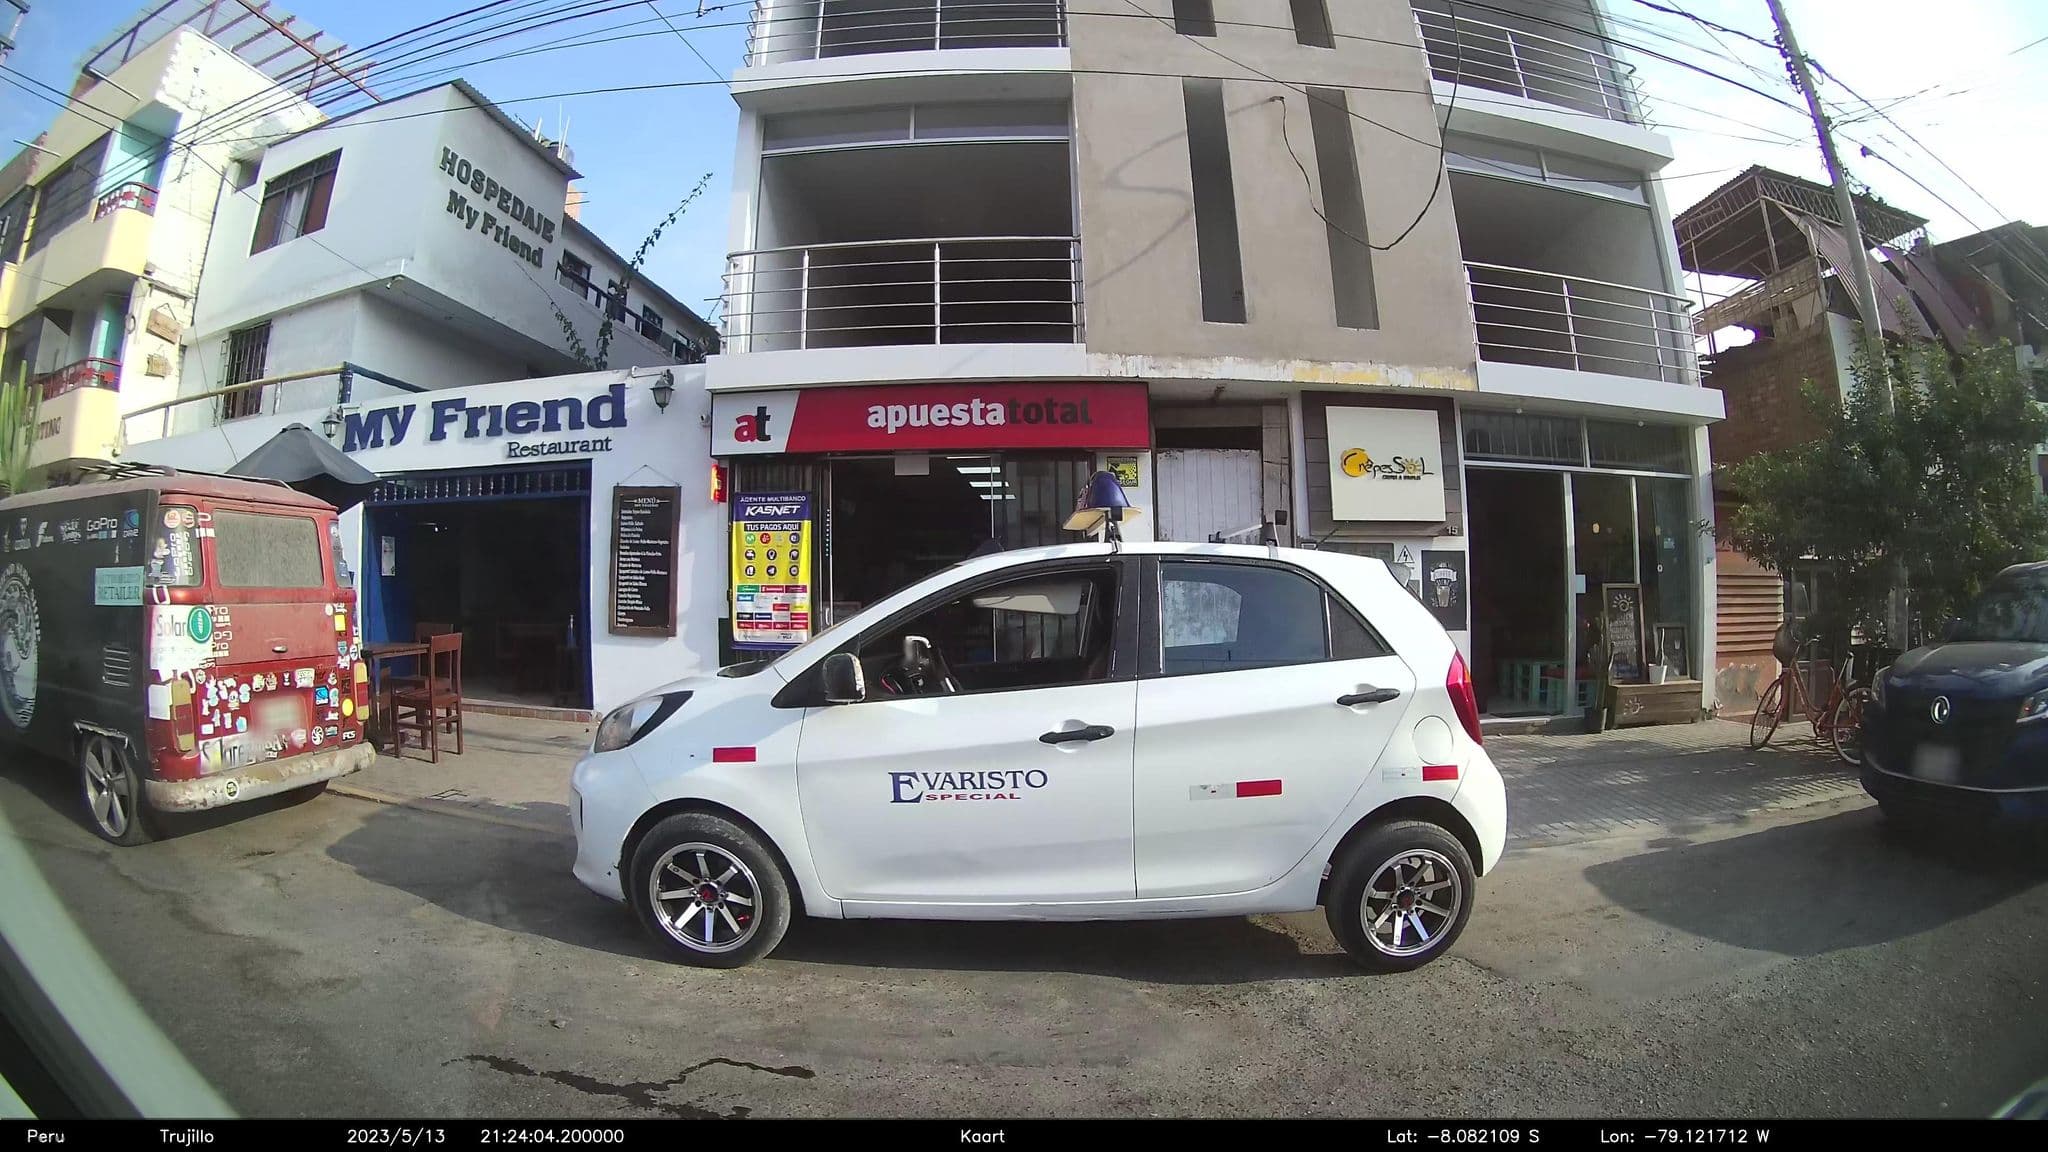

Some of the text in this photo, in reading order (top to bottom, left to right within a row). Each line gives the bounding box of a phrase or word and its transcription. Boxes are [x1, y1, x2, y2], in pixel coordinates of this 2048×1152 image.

[440, 146, 556, 244] HOSPEDAJE
[446, 189, 544, 269] My Friend
[342, 383, 628, 453] My Friend
[734, 406, 771, 443] at
[507, 437, 613, 459] Restaurant
[767, 495, 806, 503] MULTIBANCO
[745, 505, 801, 516] KASNET
[86, 517, 118, 532] GoPro
[746, 523, 759, 531] TUS
[760, 523, 782, 531] PAGOS
[888, 769, 1049, 803] EVARISTO
[925, 793, 1021, 801] SPECIAL
